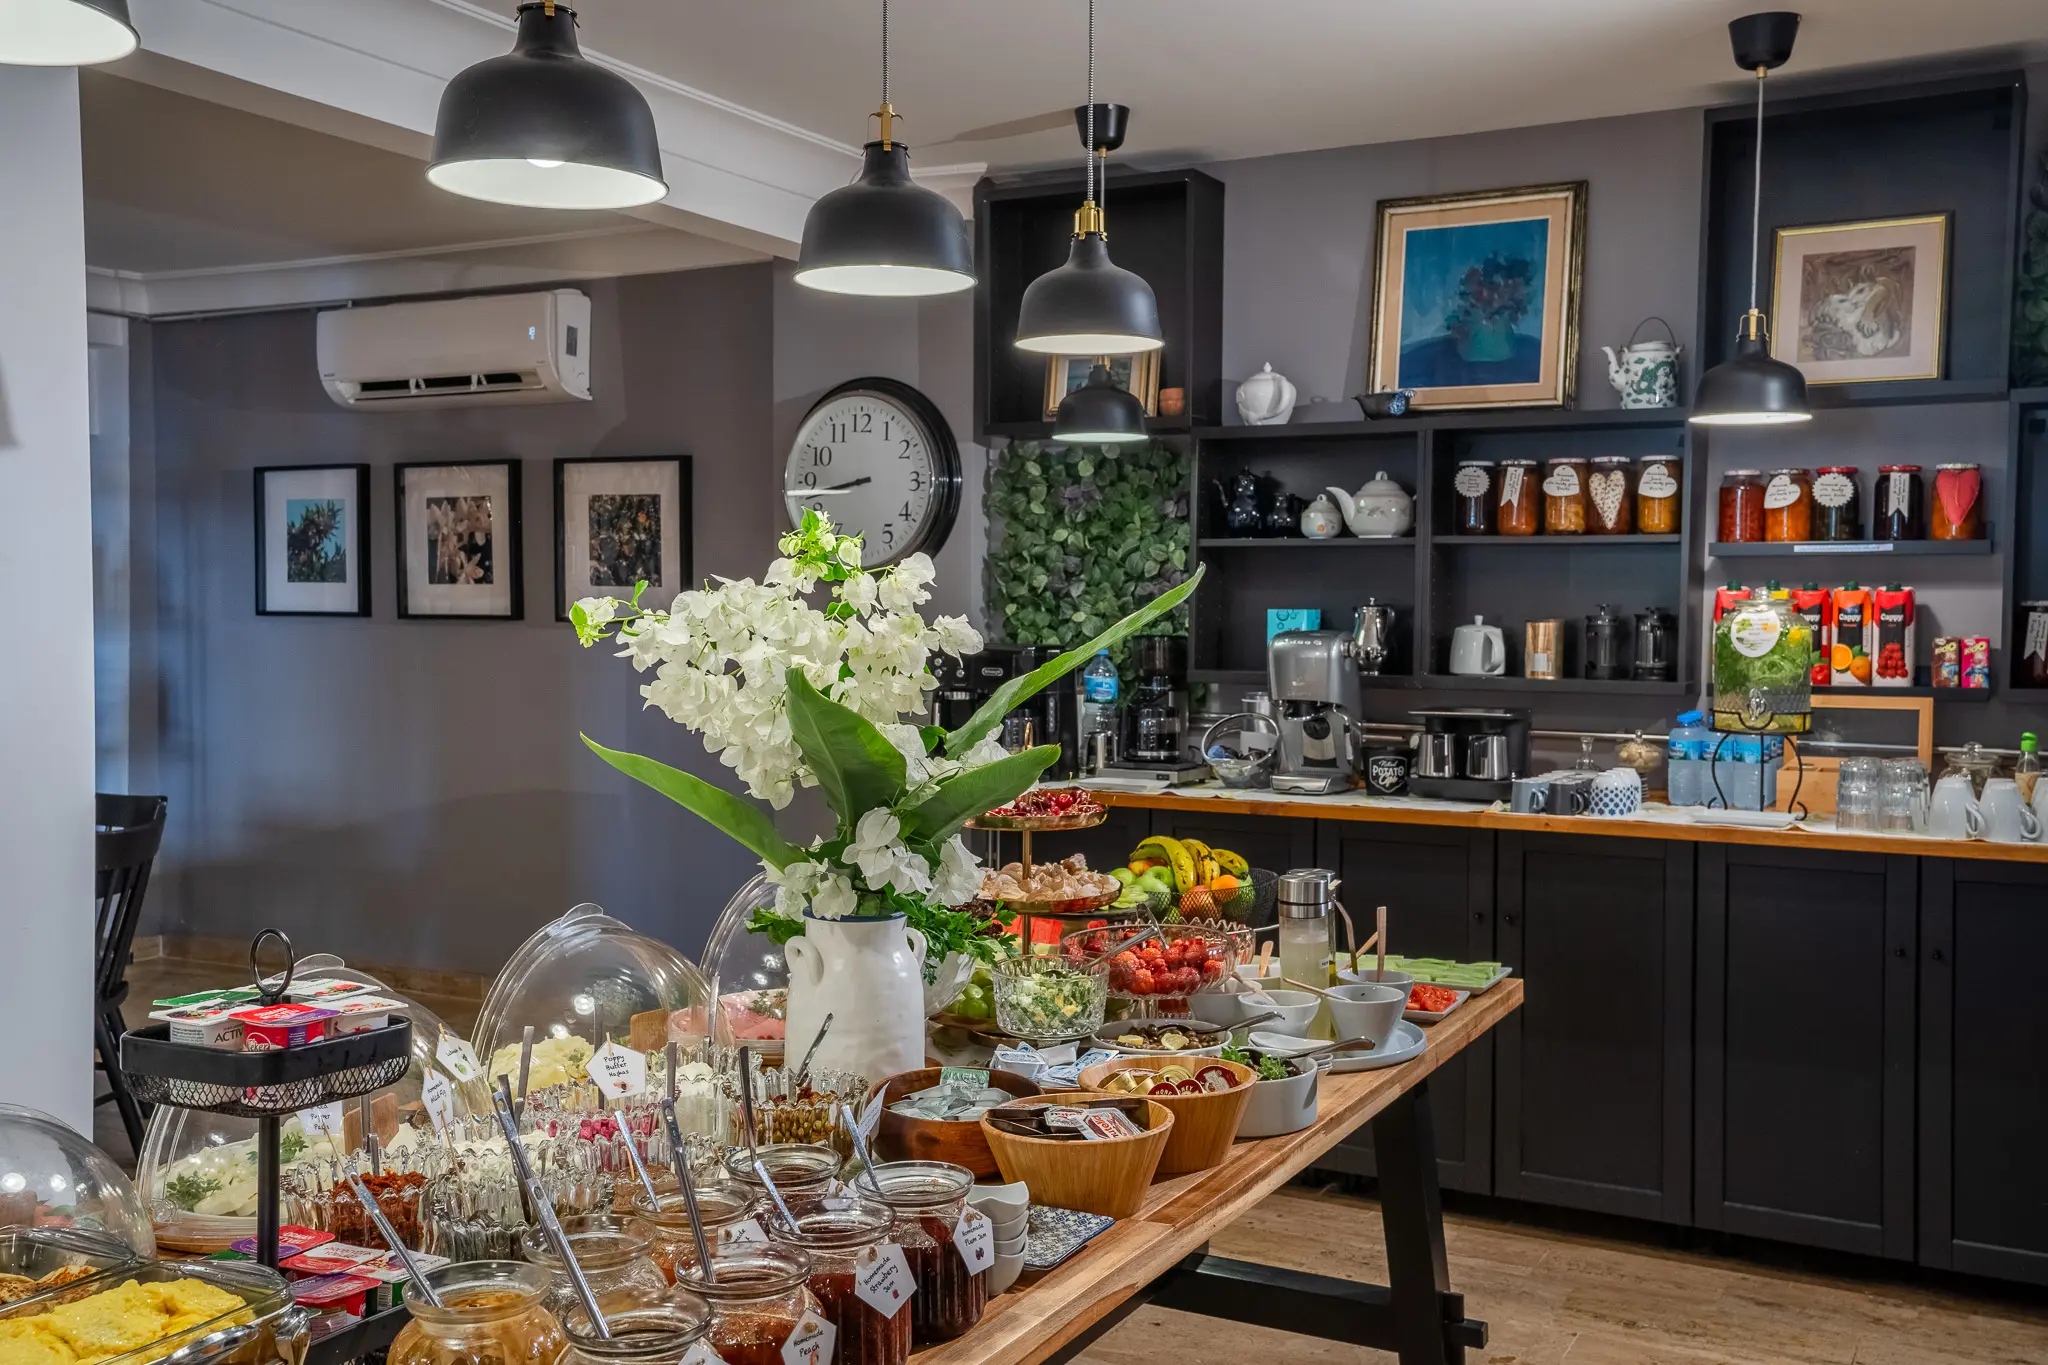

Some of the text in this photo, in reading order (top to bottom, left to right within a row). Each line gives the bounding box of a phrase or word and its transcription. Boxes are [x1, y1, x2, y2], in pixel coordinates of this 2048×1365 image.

[851, 413, 872, 433] 12
[831, 423, 847, 443] 11
[883, 421, 891, 441] 1
[812, 446, 832, 466] 10
[898, 440, 910, 459] 2
[804, 472, 817, 489] 9
[909, 471, 921, 491] 3
[898, 501, 912, 521] 4
[882, 524, 893, 544] 5
[1800, 614, 1820, 622] appy
[1839, 613, 1861, 622] Cappy
[1880, 613, 1904, 622] Cappy
[1372, 765, 1404, 776] POTATO
[214, 1028, 243, 1043] ACTIV
[603, 1055, 625, 1063] Poppy
[605, 1062, 627, 1070] Butter
[1178, 1085, 1194, 1094] ONEY
[962, 1223, 984, 1237] Homemade
[964, 1237, 977, 1247] Plum
[863, 1256, 891, 1286] Homemade
[883, 1280, 895, 1293] Jam
[793, 1329, 824, 1348] Homemade
[799, 1342, 820, 1357] Peach
